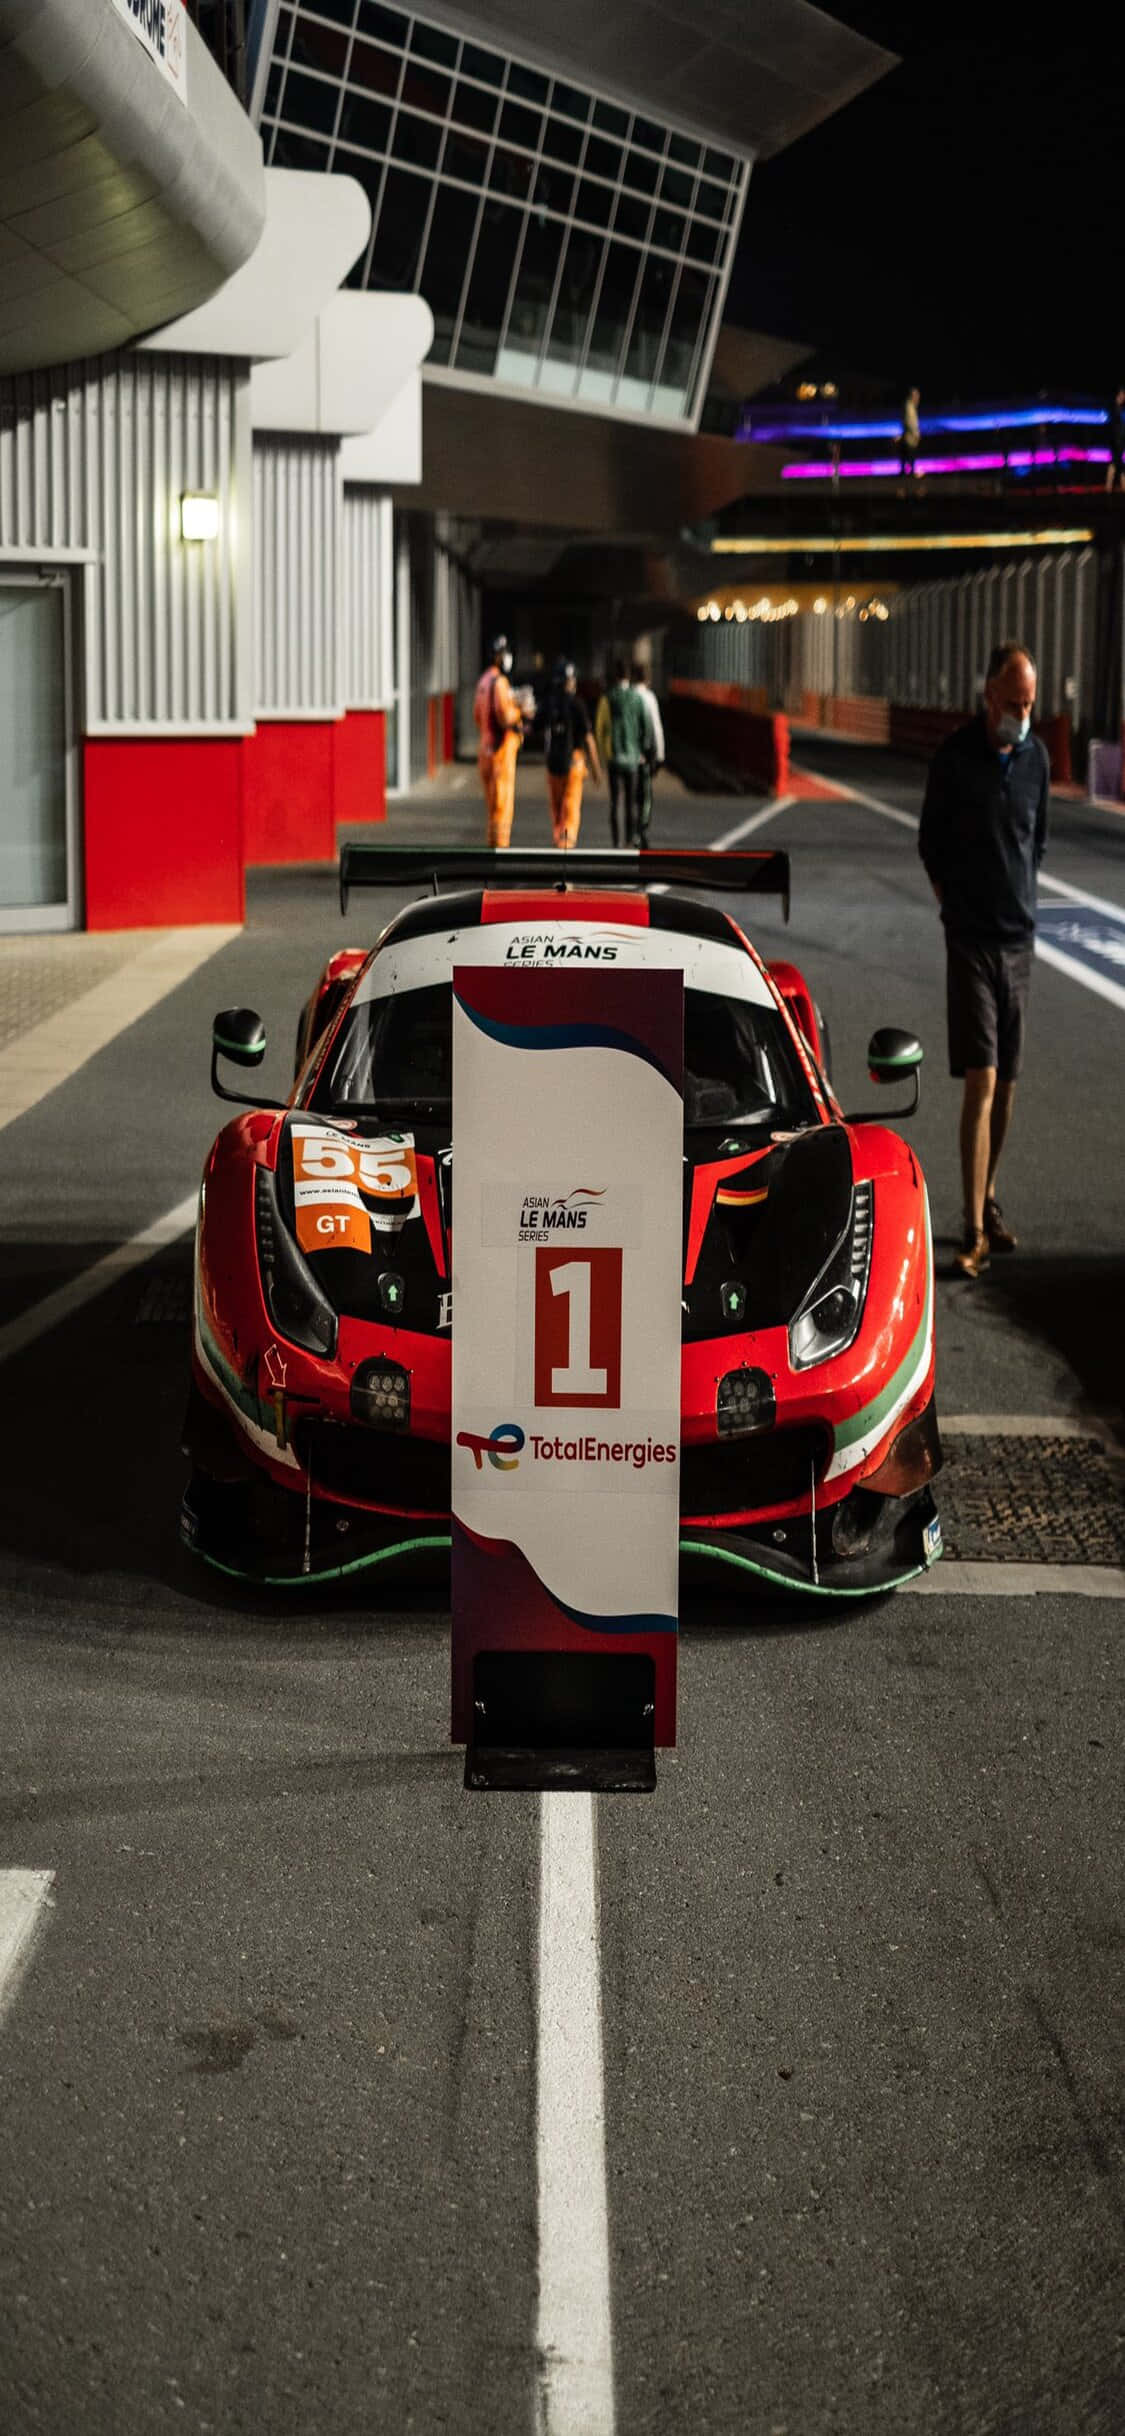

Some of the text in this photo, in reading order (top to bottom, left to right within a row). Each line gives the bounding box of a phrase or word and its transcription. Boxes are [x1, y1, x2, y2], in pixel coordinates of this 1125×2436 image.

[511, 935, 555, 945] ASIAN
[506, 945, 619, 961] LE MANS
[300, 1138, 412, 1192] 55
[522, 1197, 550, 1208] ASIAN
[316, 1215, 351, 1233] GT
[520, 1210, 587, 1229] LE MANS
[518, 1230, 550, 1242] SERIES
[549, 1261, 608, 1394] 1
[529, 1437, 677, 1468] TotalEnergies
